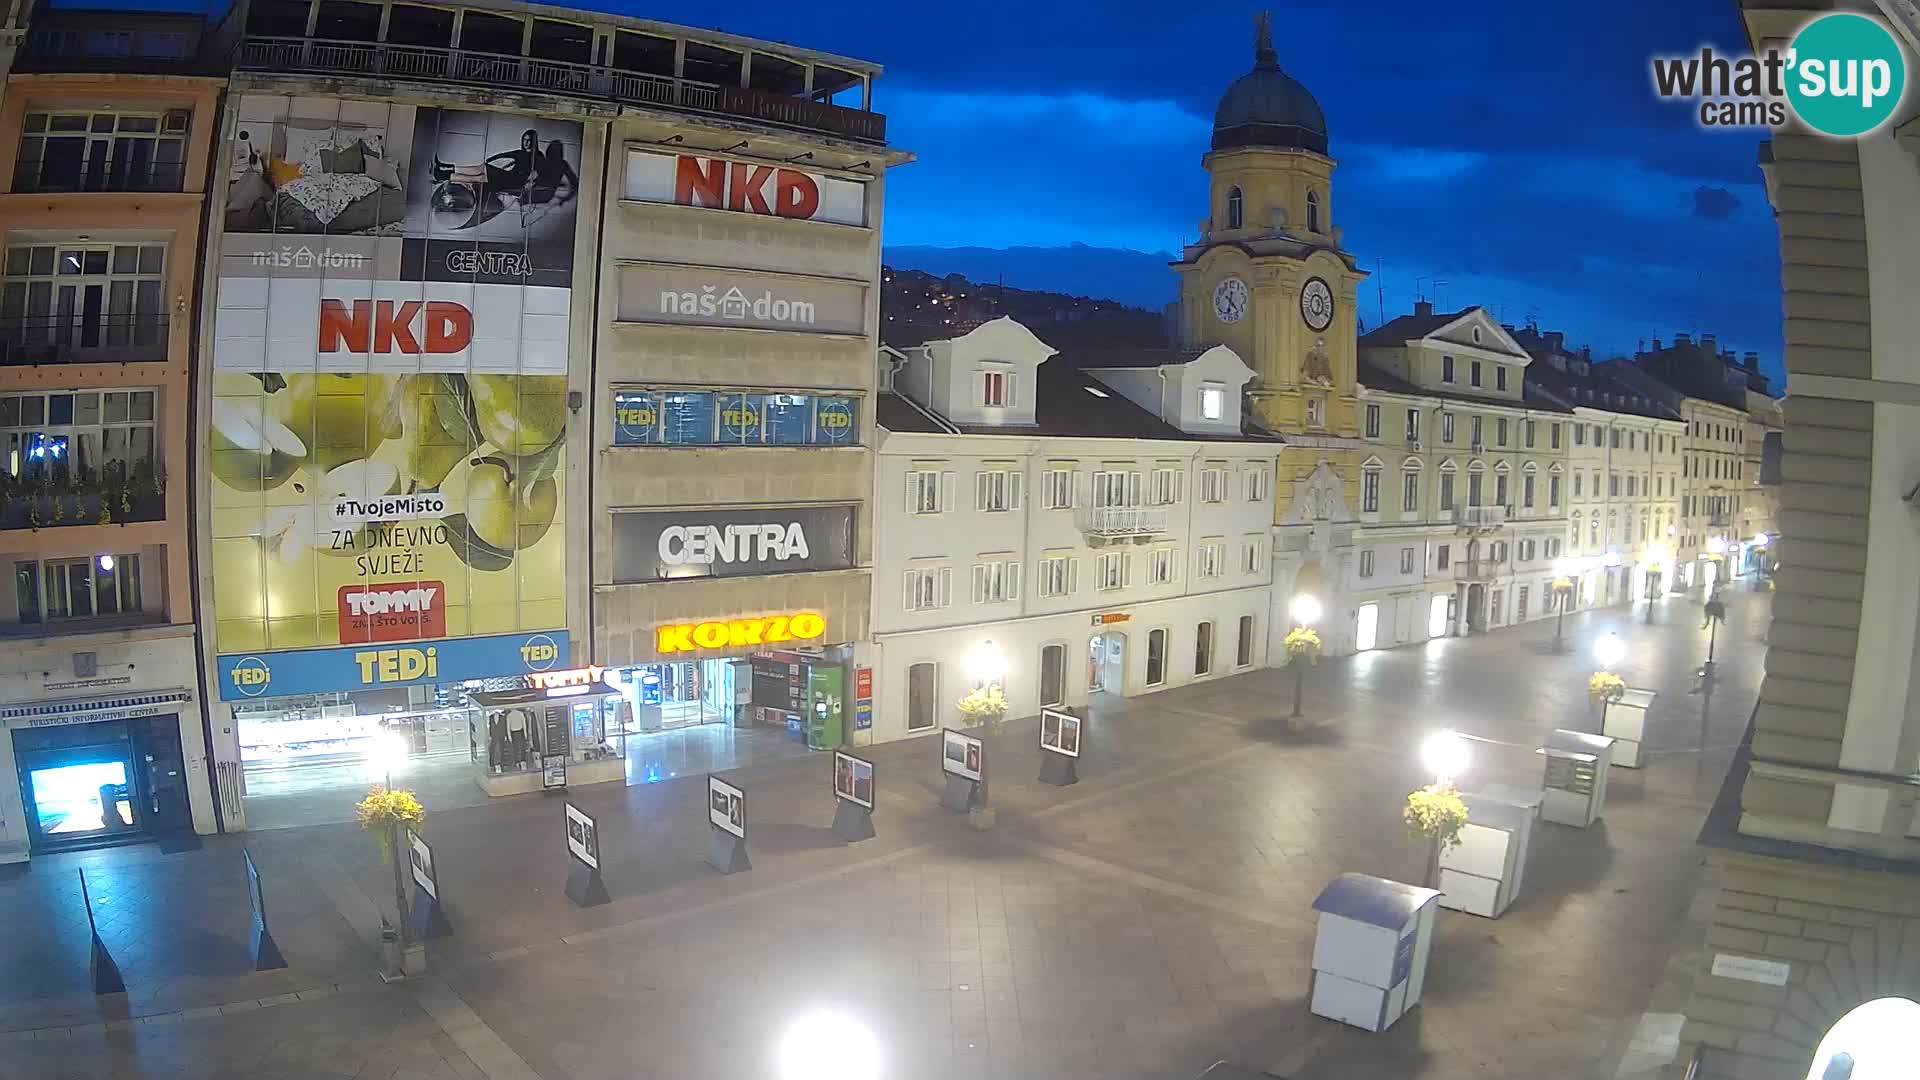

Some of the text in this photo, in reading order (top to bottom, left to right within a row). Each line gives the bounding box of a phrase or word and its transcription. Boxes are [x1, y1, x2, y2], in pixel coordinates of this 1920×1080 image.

[674, 154, 819, 219] NKD
[251, 246, 363, 269] naš dom
[446, 250, 532, 276] CENTRA
[660, 284, 815, 323] naš dom
[319, 298, 475, 354] NKD
[618, 409, 656, 425] TEDi
[723, 410, 758, 426] TEDi
[336, 498, 444, 517] #TvojeMisto
[331, 525, 448, 550] ZA DNEVNO
[658, 522, 809, 565] CENTRA
[357, 549, 424, 576] SVJEŽE
[346, 588, 437, 616] TOMMY
[656, 613, 825, 653] KORZO
[355, 647, 438, 684] TEDi
[521, 645, 558, 661] TEDi
[231, 666, 271, 685] TEDi
[529, 664, 604, 689] TOMMY
